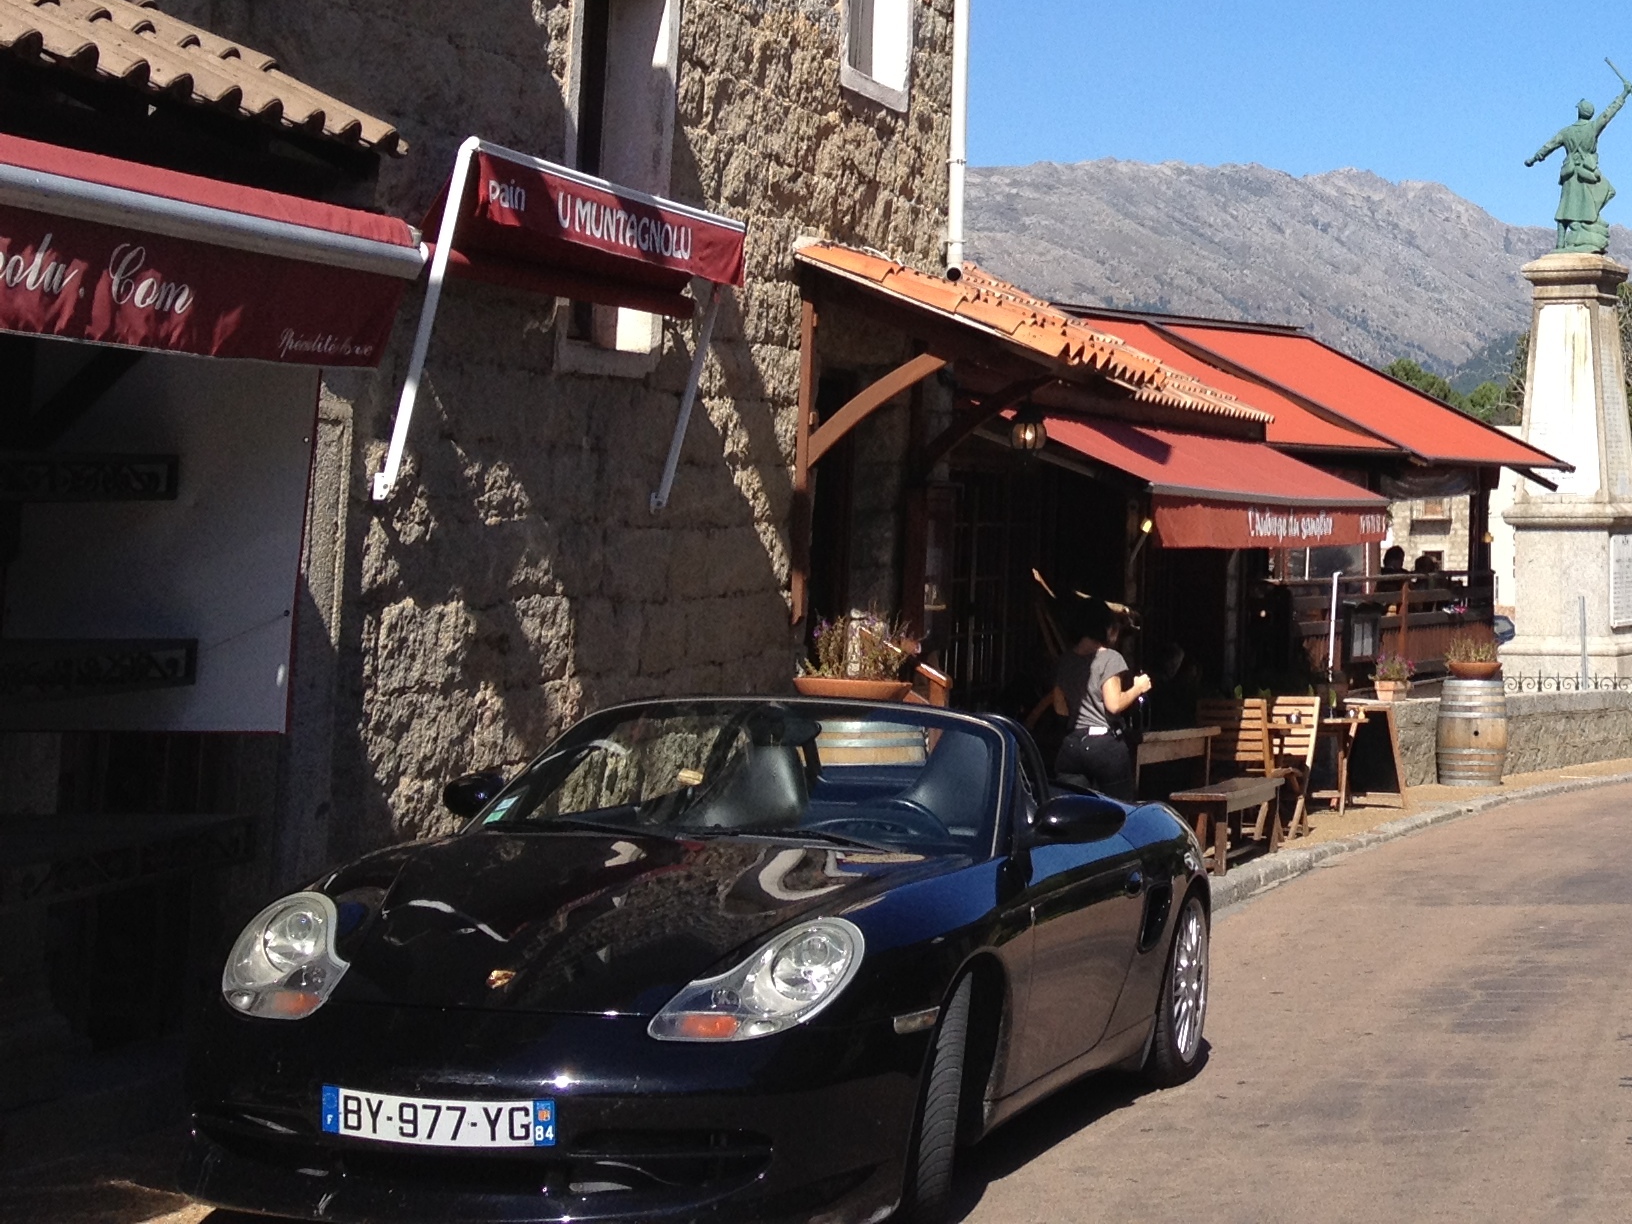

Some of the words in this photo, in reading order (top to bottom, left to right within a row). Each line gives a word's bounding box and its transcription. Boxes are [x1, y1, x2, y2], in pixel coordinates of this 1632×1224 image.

[557, 191, 571, 228] U
[574, 196, 692, 260] MUNTAGNOLU
[109, 242, 194, 314] Com
[342, 1094, 532, 1142] BY-977-YG
[535, 1125, 554, 1140] 84
